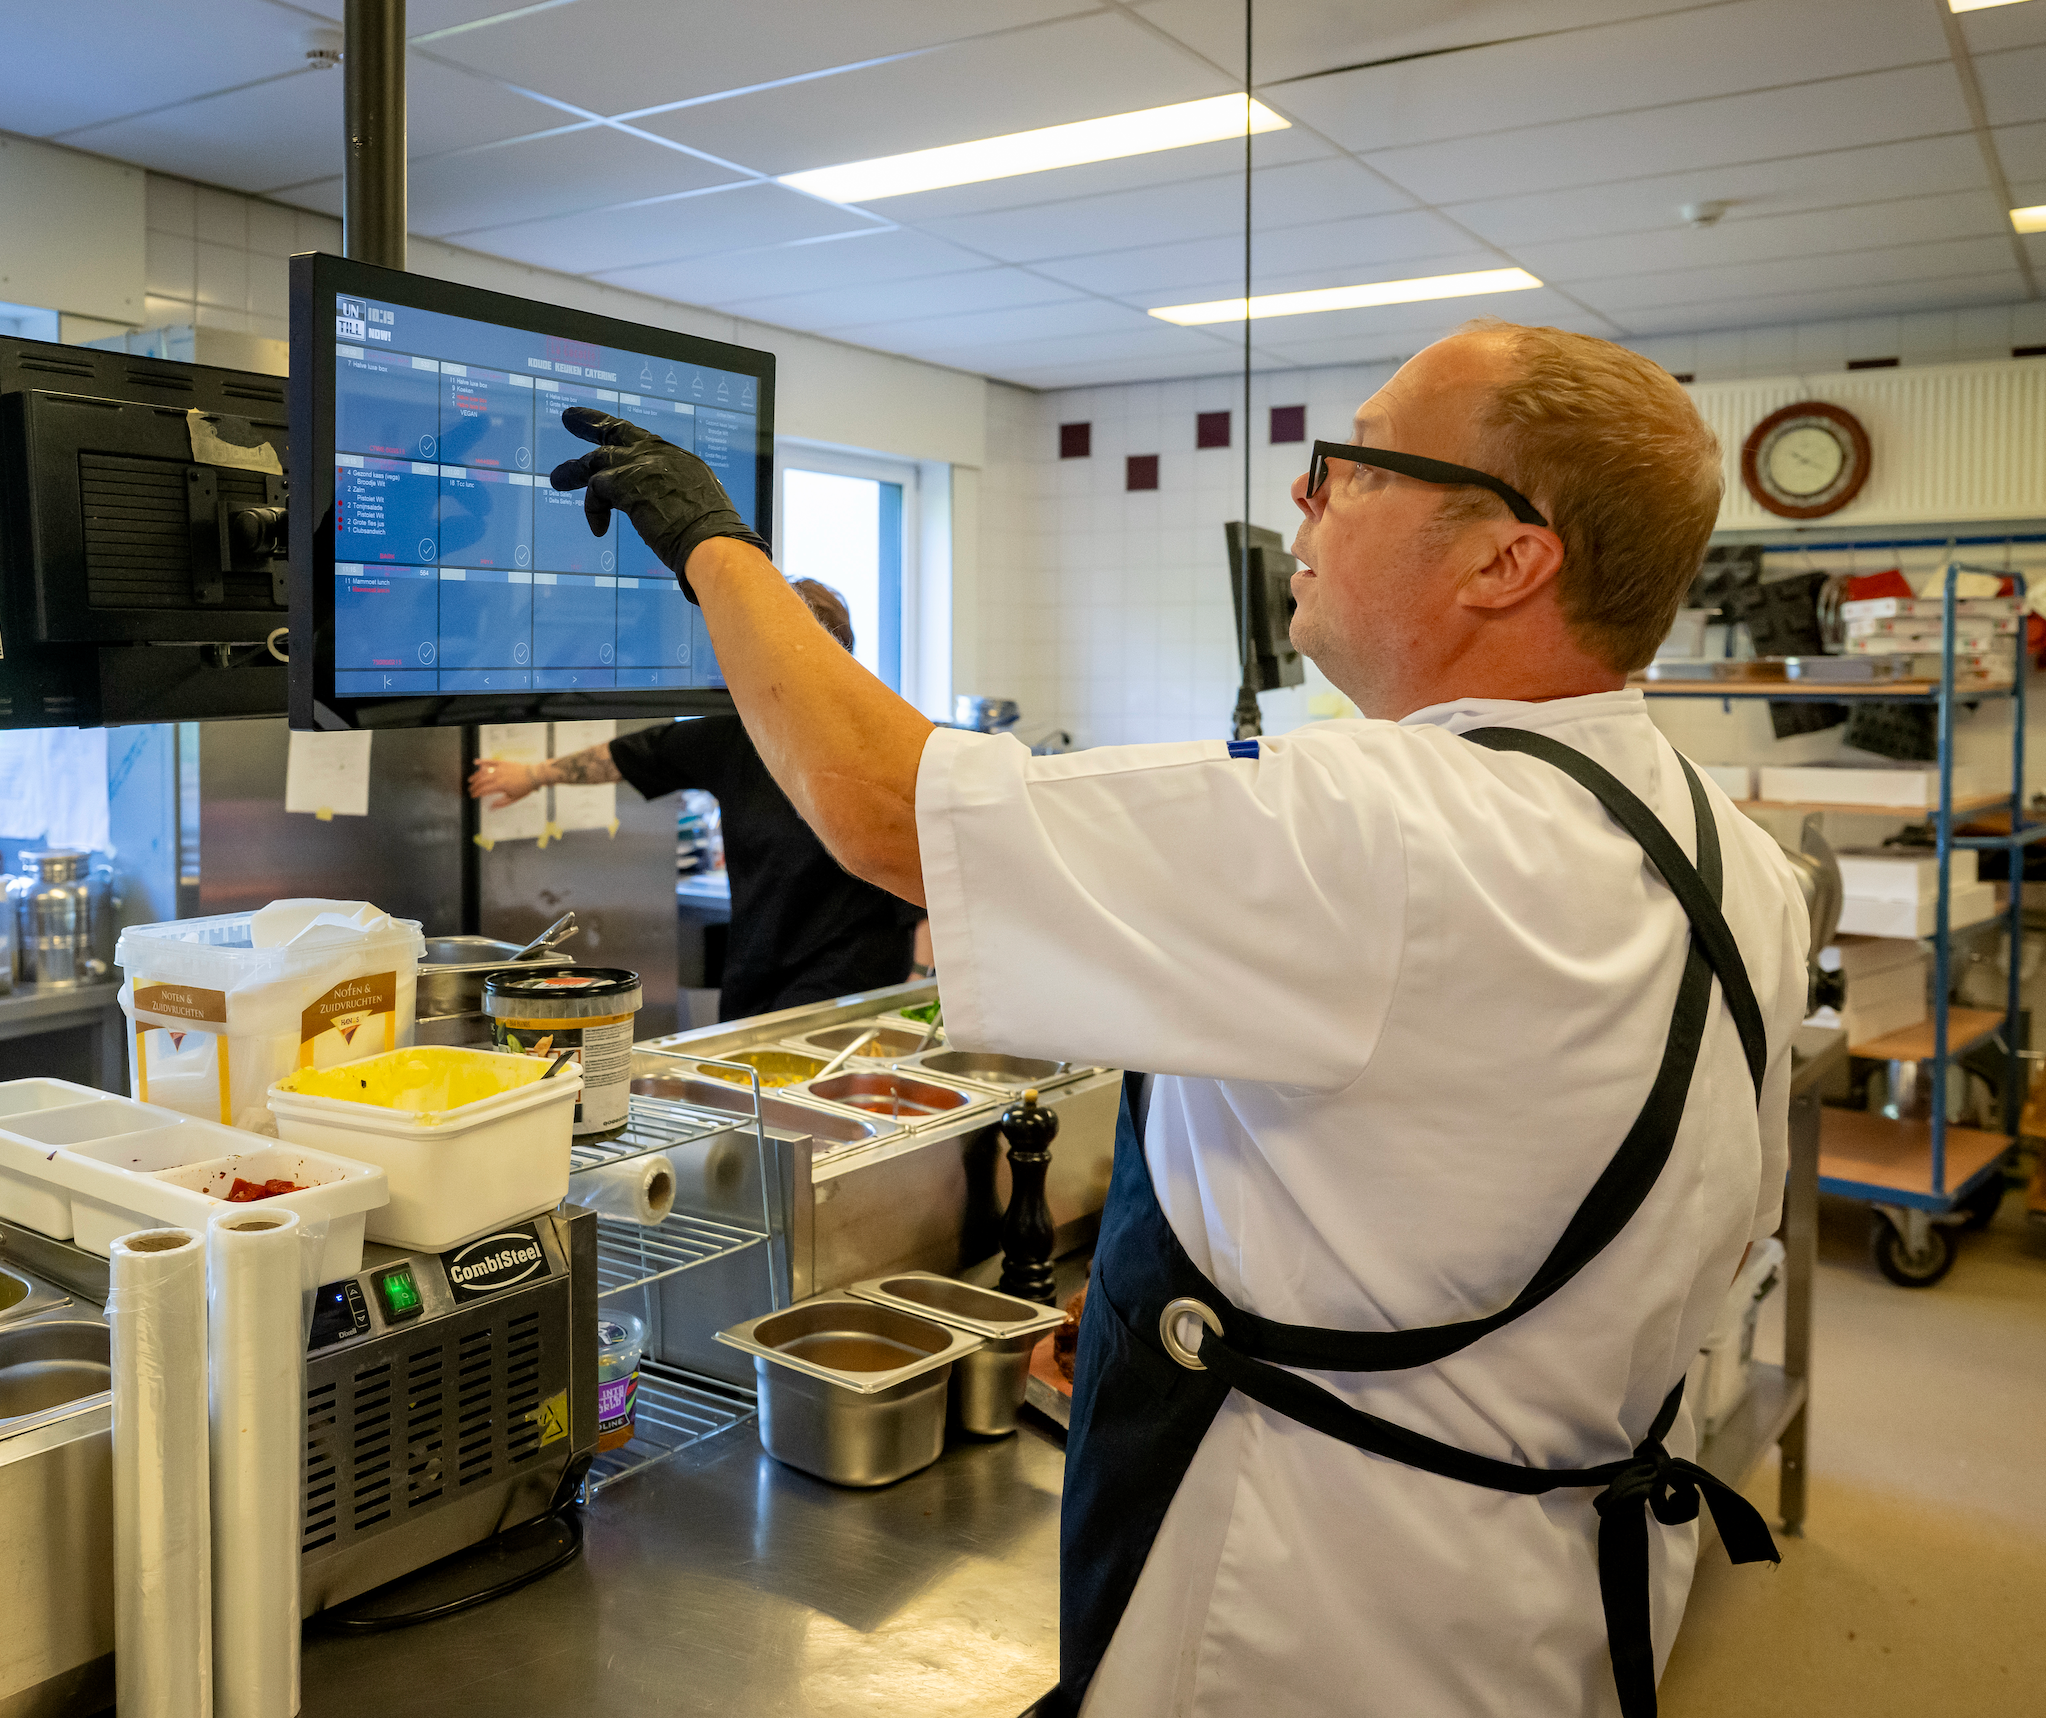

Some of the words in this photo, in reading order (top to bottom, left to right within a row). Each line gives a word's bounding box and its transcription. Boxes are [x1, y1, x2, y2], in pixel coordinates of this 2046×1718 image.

[342, 302, 359, 318] UN
[368, 308, 394, 325] 10:19
[339, 320, 362, 336] TILL
[368, 328, 391, 342] NOW!
[352, 361, 367, 369] Halve
[368, 362, 378, 371] luxe
[378, 364, 388, 373] box
[528, 357, 552, 370] KOUDE
[555, 362, 582, 376] KEUKEN
[585, 368, 617, 382] CATERING
[457, 378, 469, 387] Halve
[470, 379, 478, 387] luxe
[460, 409, 478, 417] VEGAN
[353, 470, 372, 478] Gezond
[385, 473, 400, 481] (vega)
[357, 478, 376, 487] Broodje
[353, 503, 383, 511] Tonijnsalade
[353, 527, 386, 535] Clubsandwich
[364, 984, 371, 994] &
[186, 994, 193, 1004] &
[320, 995, 383, 1014] ZUIDVRUCHTEN
[152, 1000, 204, 1018] ZUIDVRUCHTEN
[450, 1242, 542, 1283] CombiSteel
[602, 1384, 624, 1398] INTO
